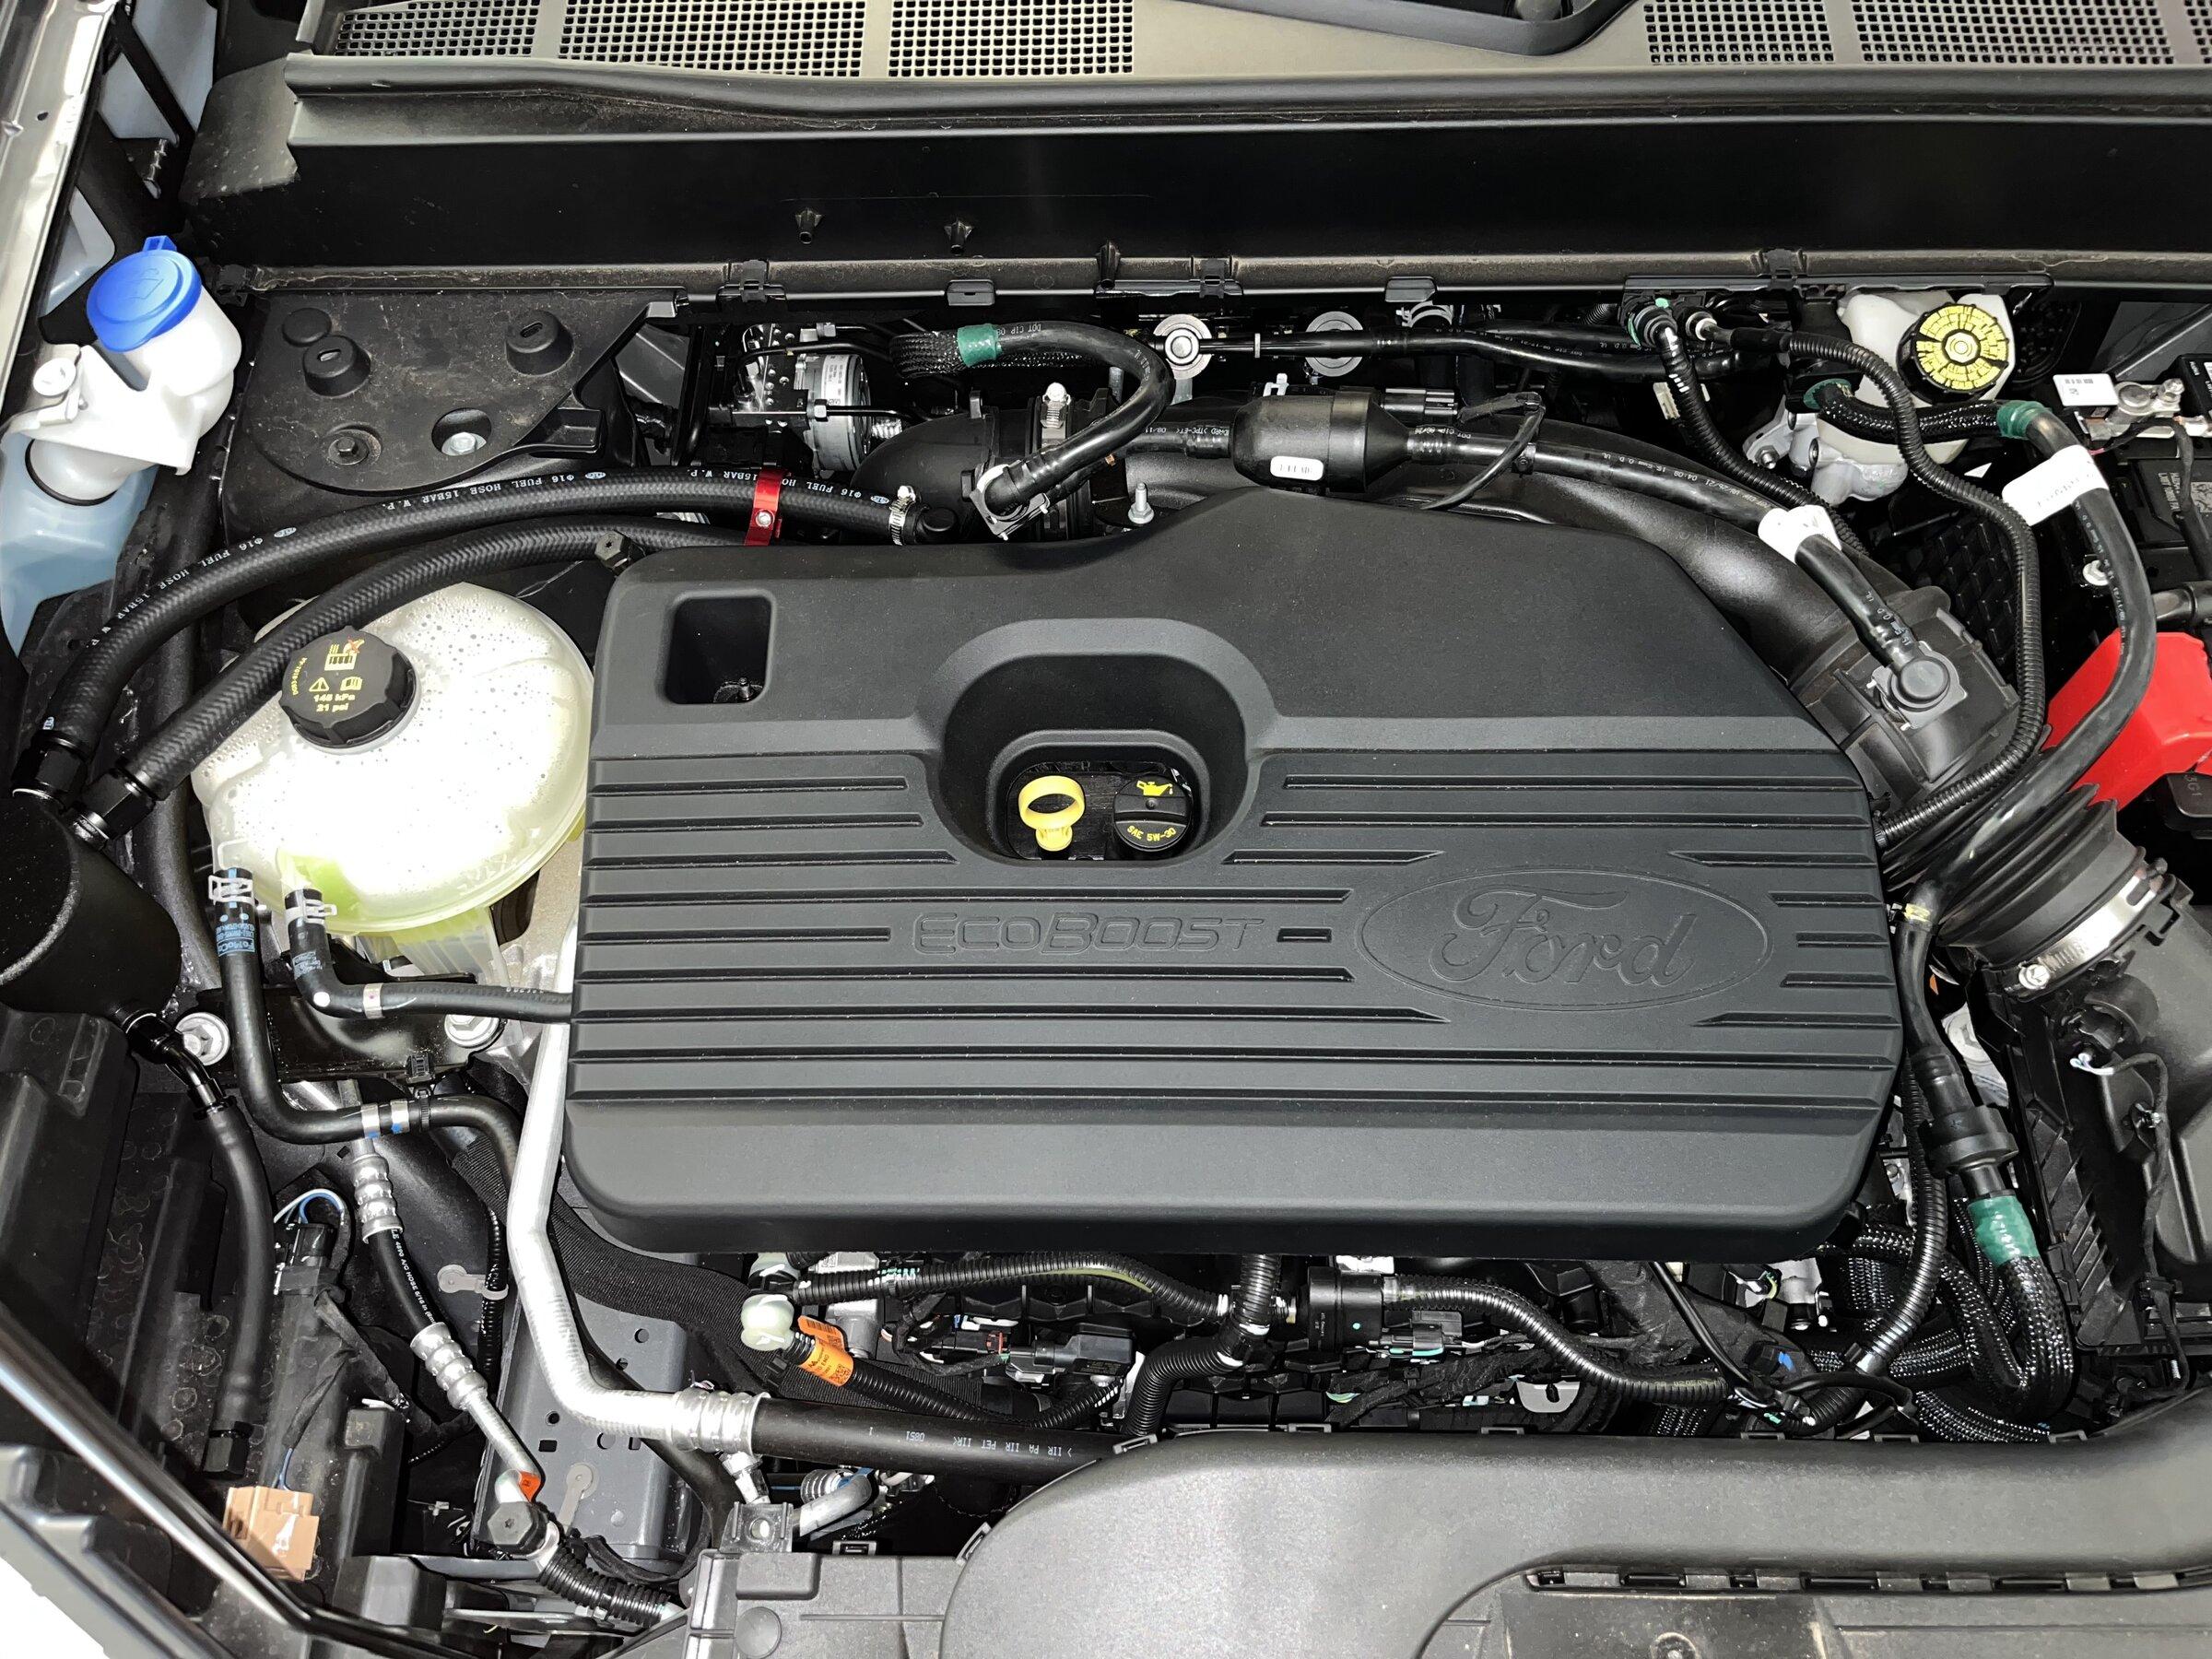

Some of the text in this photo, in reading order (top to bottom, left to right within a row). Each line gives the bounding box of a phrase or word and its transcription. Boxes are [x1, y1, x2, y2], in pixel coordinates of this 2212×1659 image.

[512, 477, 543, 488] FUEL
[724, 470, 759, 481] 15BAR
[470, 482, 502, 496] HOSE
[806, 480, 834, 494] FUEL
[422, 488, 460, 504] 15BAR
[198, 548, 231, 568] FUEL
[158, 568, 190, 591] HOSE
[316, 702, 349, 712] 21 psi
[1126, 825, 1177, 841] SAE 5W-30
[1429, 883, 1698, 987] Ford
[406, 1271, 418, 1290] HOSE
[981, 1439, 997, 1451] PET
[1029, 1443, 1040, 1454] PA
